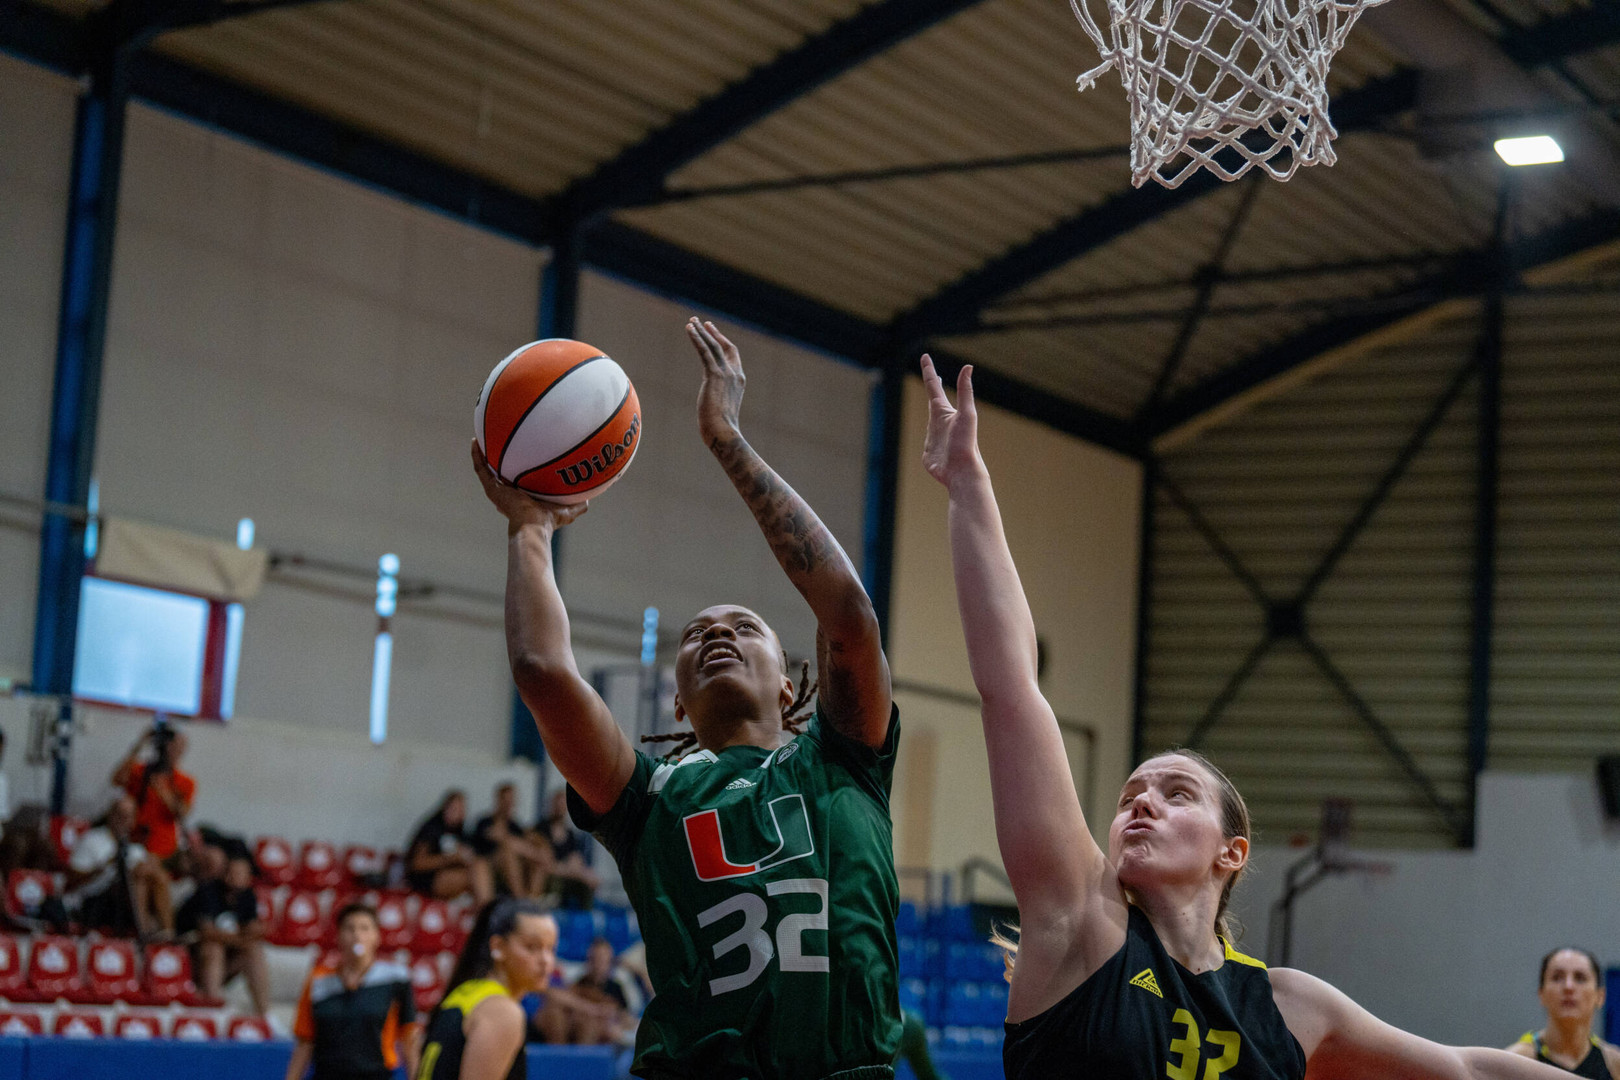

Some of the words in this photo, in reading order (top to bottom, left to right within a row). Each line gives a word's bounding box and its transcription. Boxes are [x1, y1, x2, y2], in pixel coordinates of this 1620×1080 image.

[556, 413, 640, 486] Wilson
[697, 878, 830, 997] 32
[1166, 1008, 1241, 1080] 32
